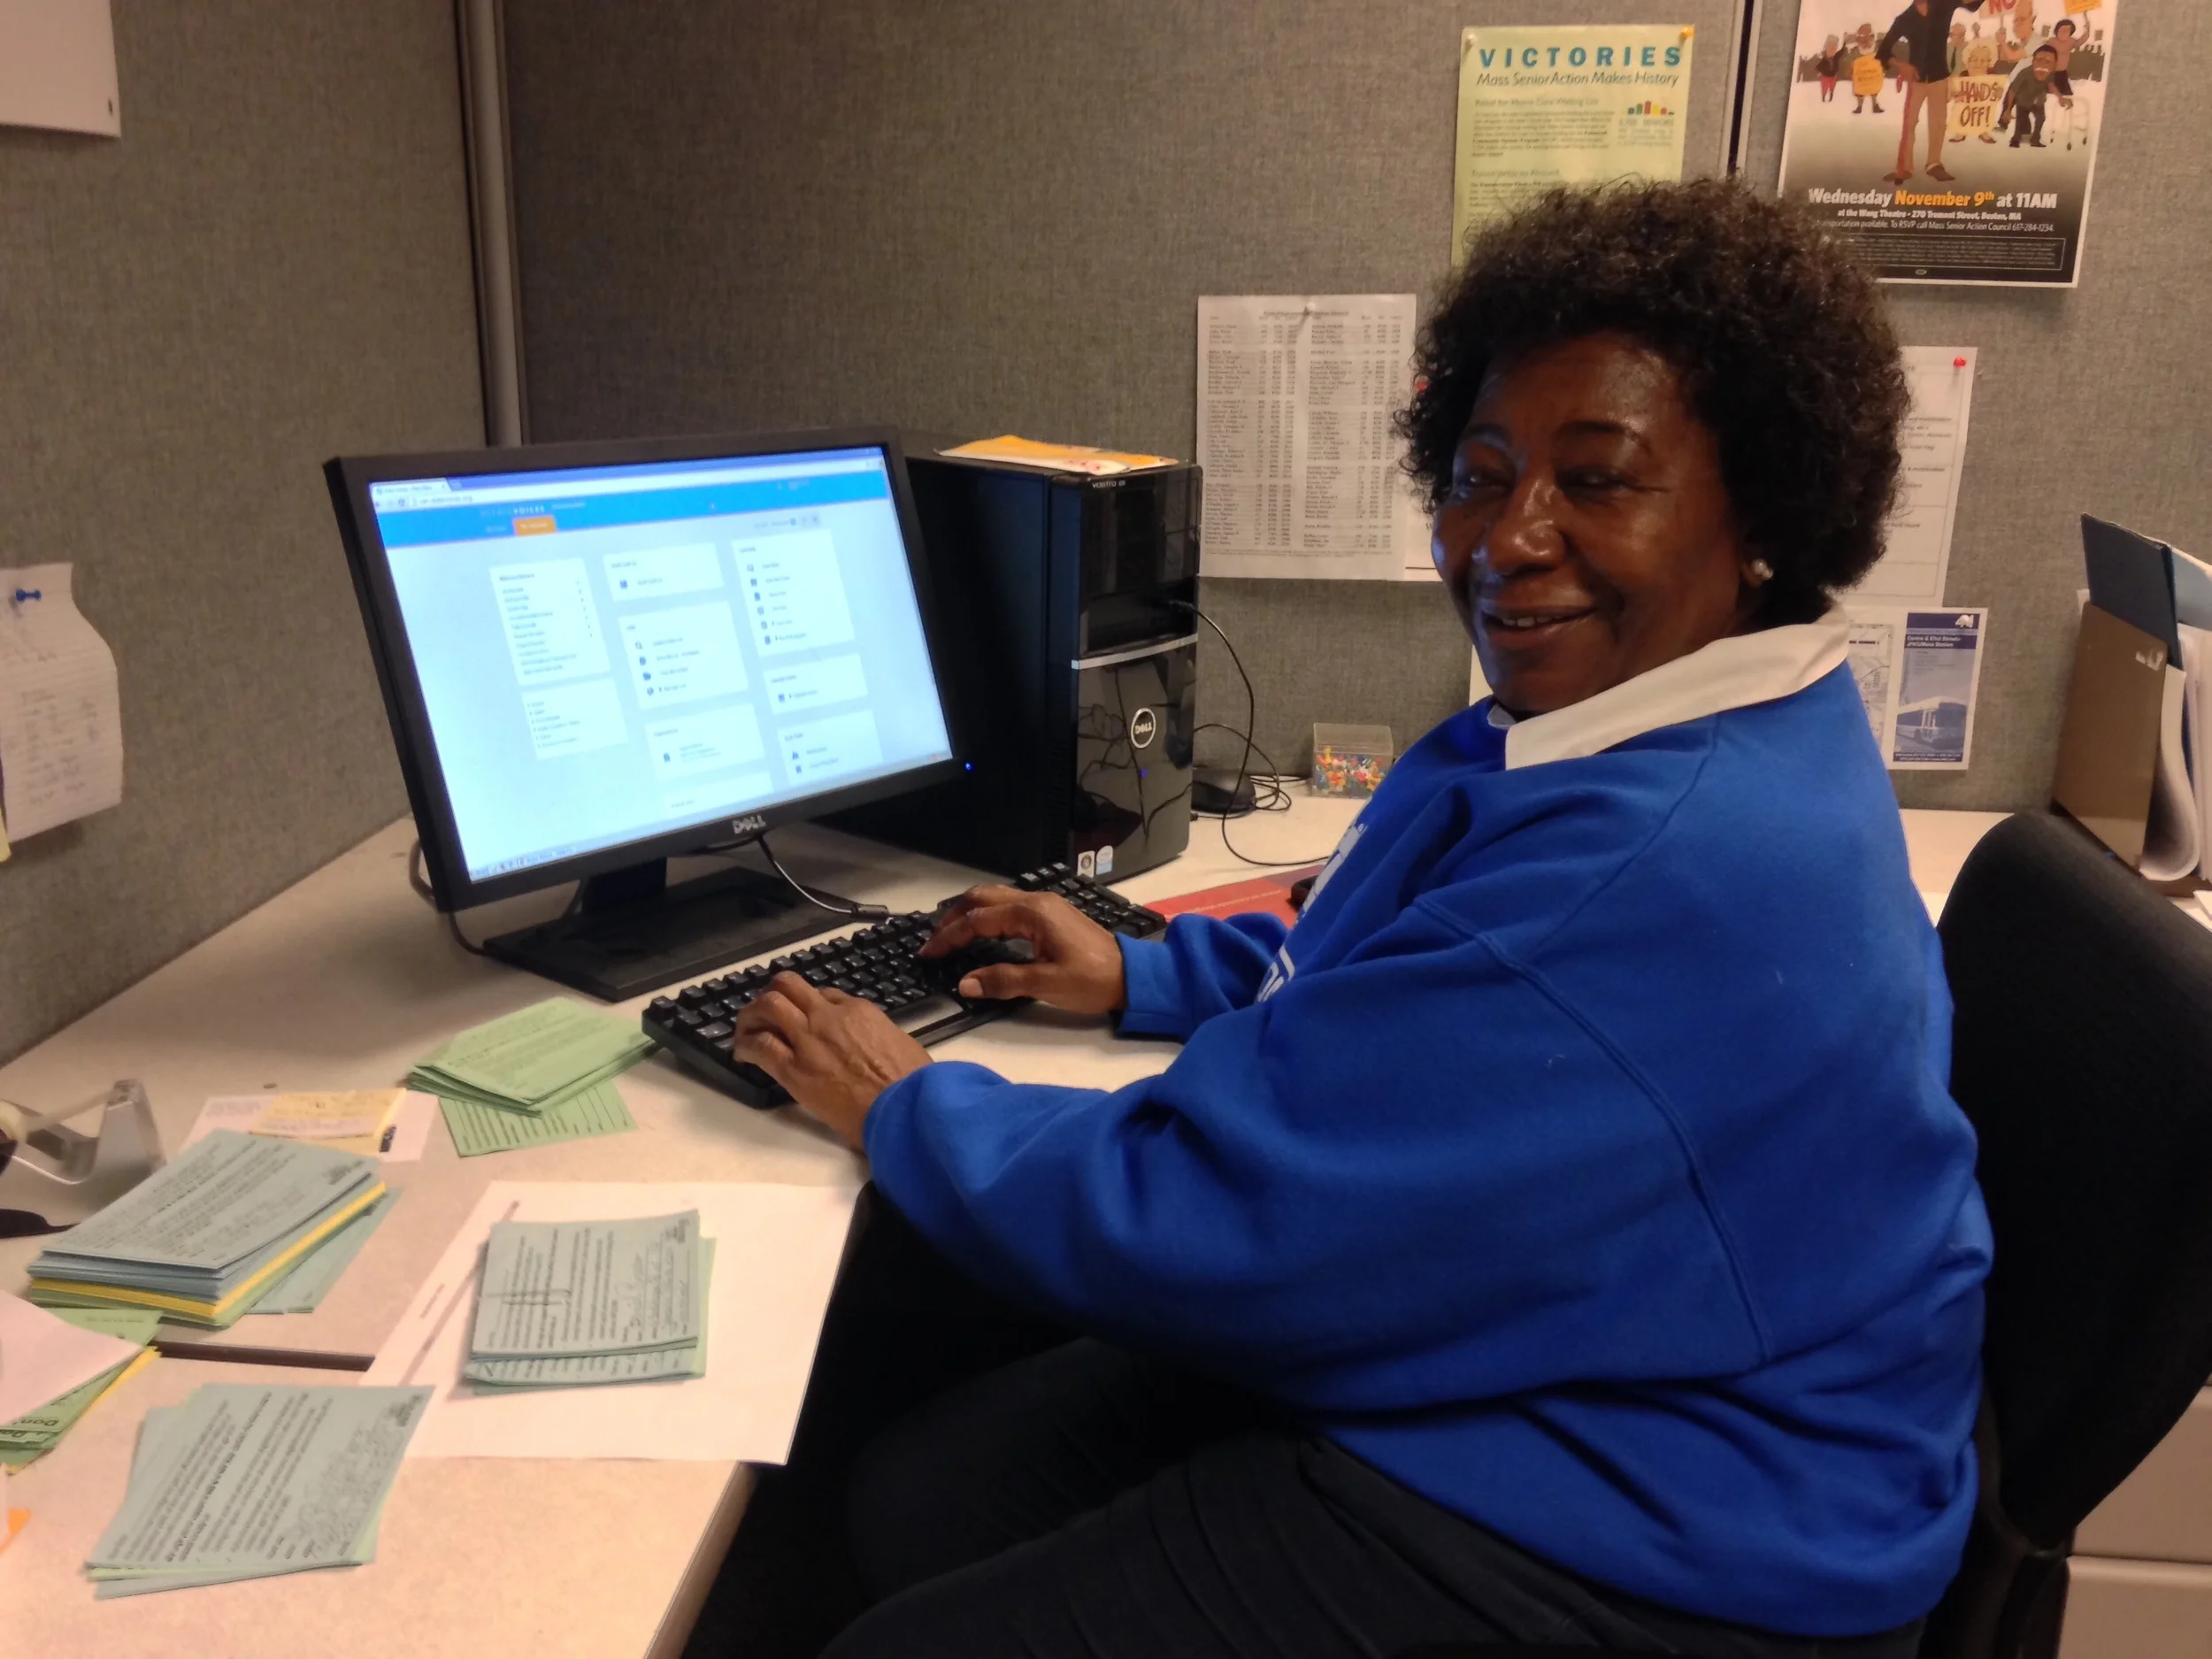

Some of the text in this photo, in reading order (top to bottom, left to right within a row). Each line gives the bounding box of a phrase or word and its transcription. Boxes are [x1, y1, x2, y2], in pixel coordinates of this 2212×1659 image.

[1479, 46, 1681, 68] VICTORIES
[1476, 71, 1679, 88] Mass Senior Action Makes History
[1960, 81, 1998, 103] HANDS
[1960, 105, 1991, 127] OFF!
[1808, 188, 2058, 209] Wednesday November 9th at 11AM
[1911, 210, 1926, 219] 270
[1891, 219, 1898, 228] To
[1899, 220, 1916, 229] RSVP
[1988, 222, 2011, 231] Council
[1133, 722, 1153, 735] DELL
[733, 814, 766, 833] DELL
